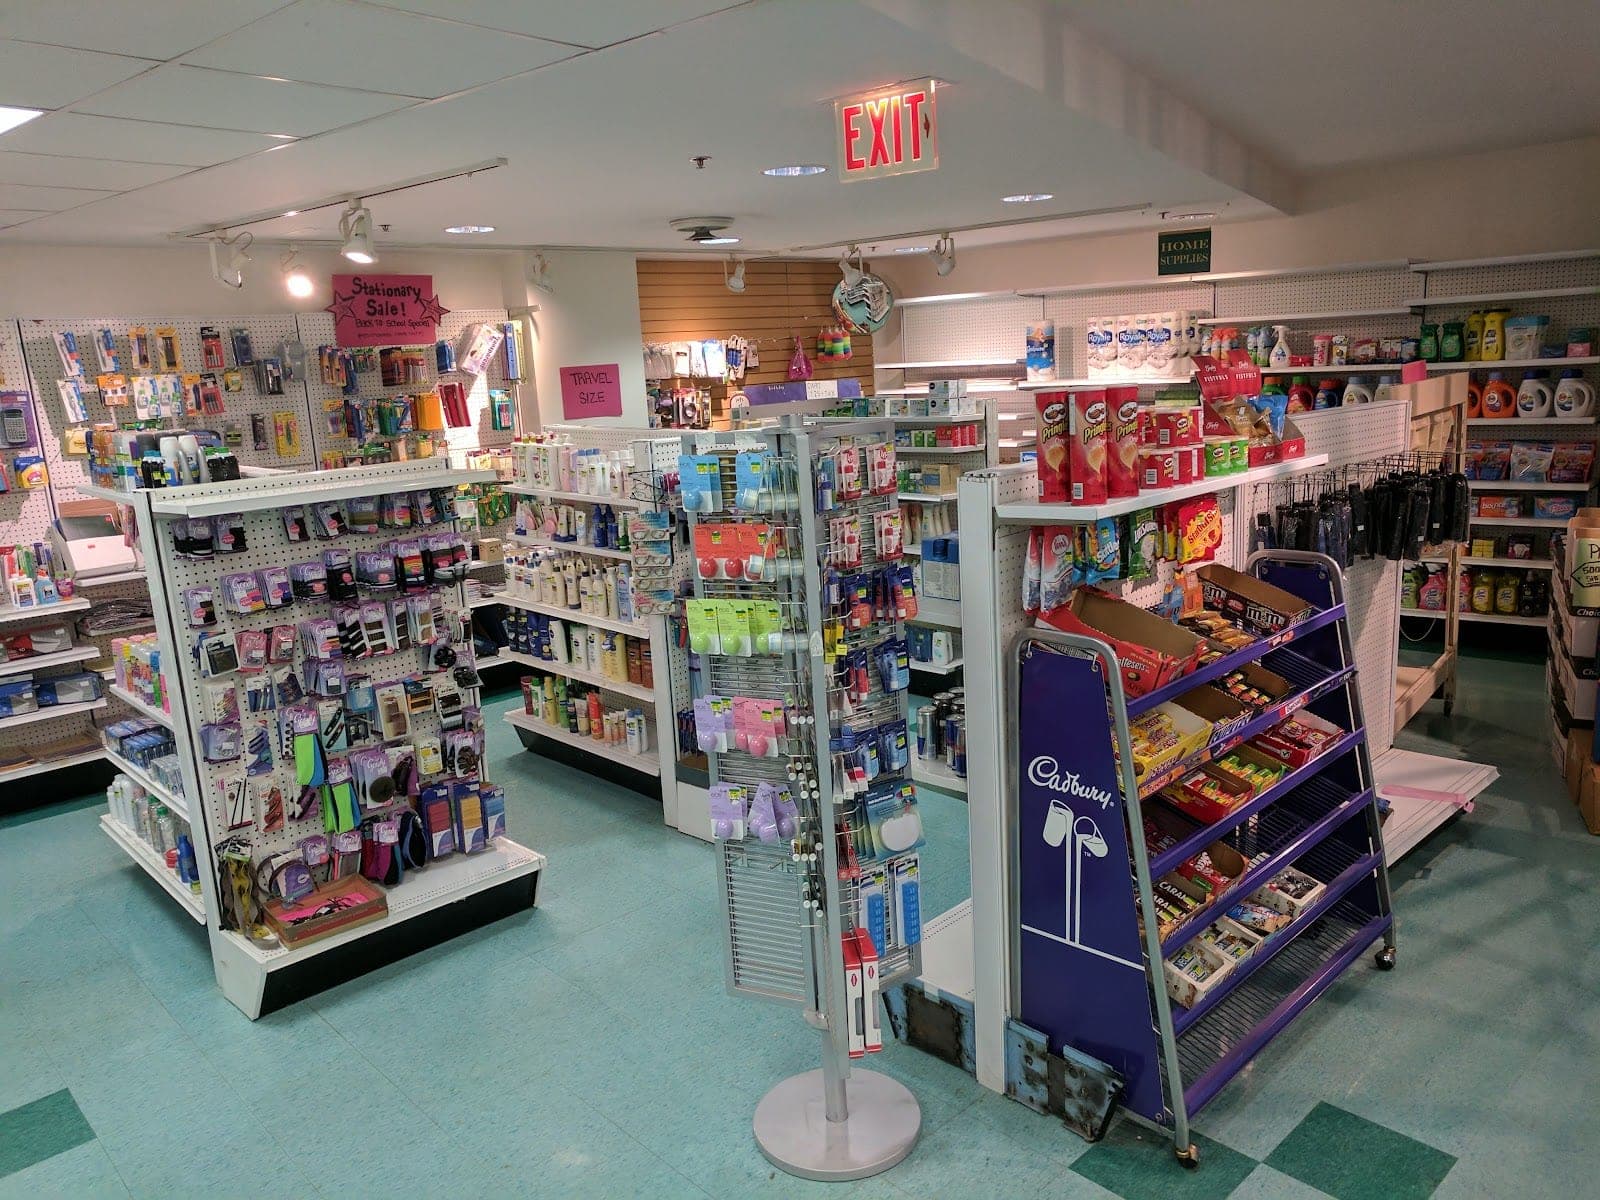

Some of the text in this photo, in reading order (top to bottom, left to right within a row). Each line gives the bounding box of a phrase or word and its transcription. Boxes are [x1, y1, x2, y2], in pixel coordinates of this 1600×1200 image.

[843, 91, 926, 172] EXIT
[1161, 240, 1209, 252] HOME
[1161, 253, 1209, 265] SUPPLIES
[352, 276, 421, 304] Stationary
[366, 299, 406, 316] Sale!
[1088, 330, 1112, 344] Royale
[1119, 330, 1145, 344] Royale
[1147, 329, 1170, 344] Royale
[570, 372, 613, 386] TRAVEL
[579, 391, 605, 405] SIZE
[1577, 608, 1600, 617] Choic
[1117, 657, 1146, 672] altesers
[1028, 755, 1113, 810] Cadbury
